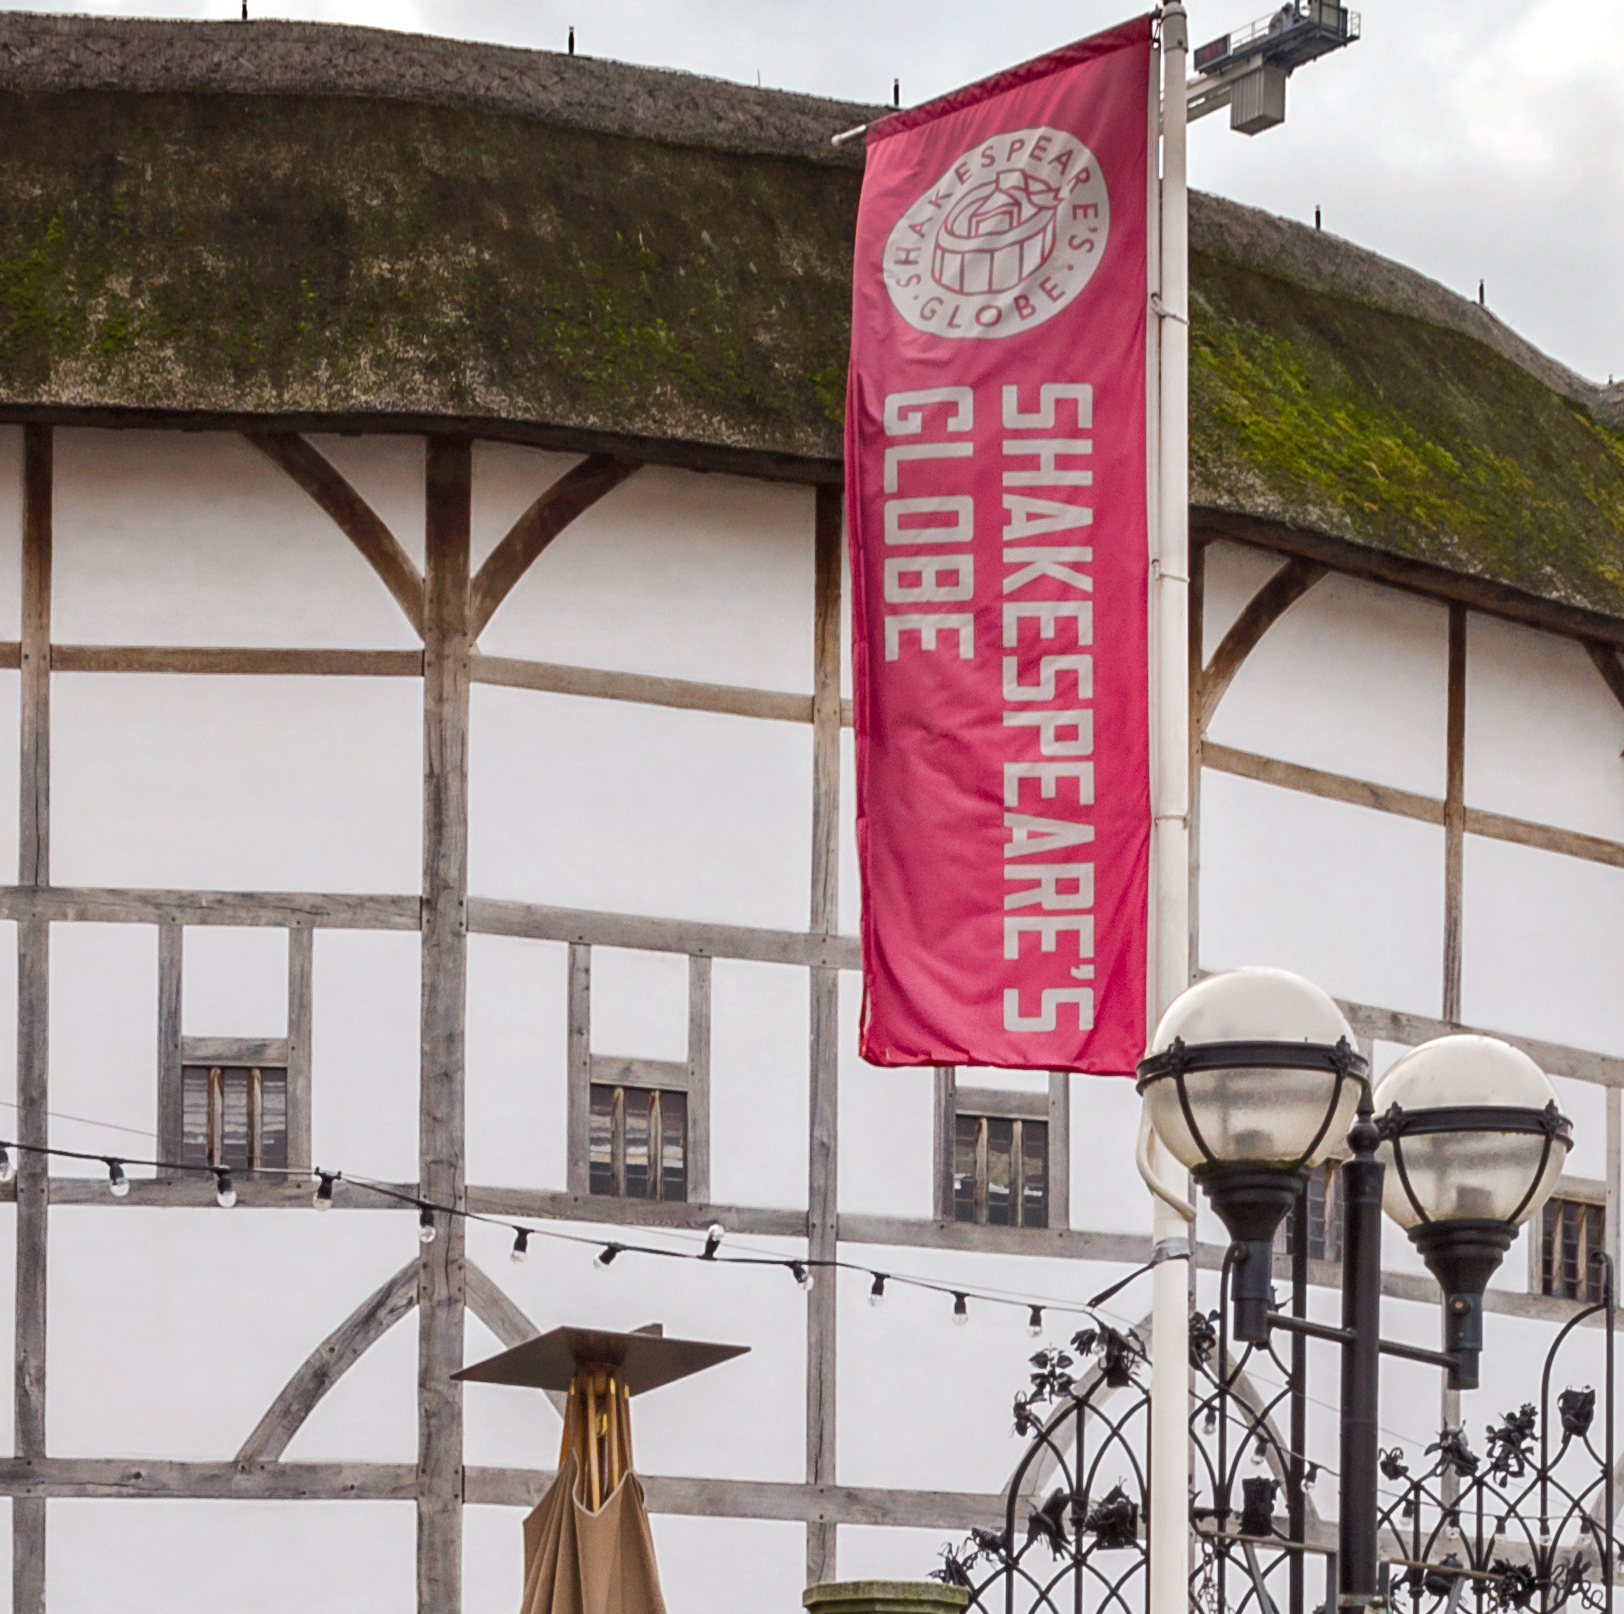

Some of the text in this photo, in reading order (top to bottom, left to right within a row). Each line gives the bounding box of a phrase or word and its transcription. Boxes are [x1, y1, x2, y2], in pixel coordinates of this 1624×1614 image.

[893, 133, 1099, 289] SHAKESPEARE'S
[919, 274, 1066, 329] GLOBE
[882, 384, 975, 663] GLOBE
[1001, 381, 1096, 1034] SHAKESPEARE'S
